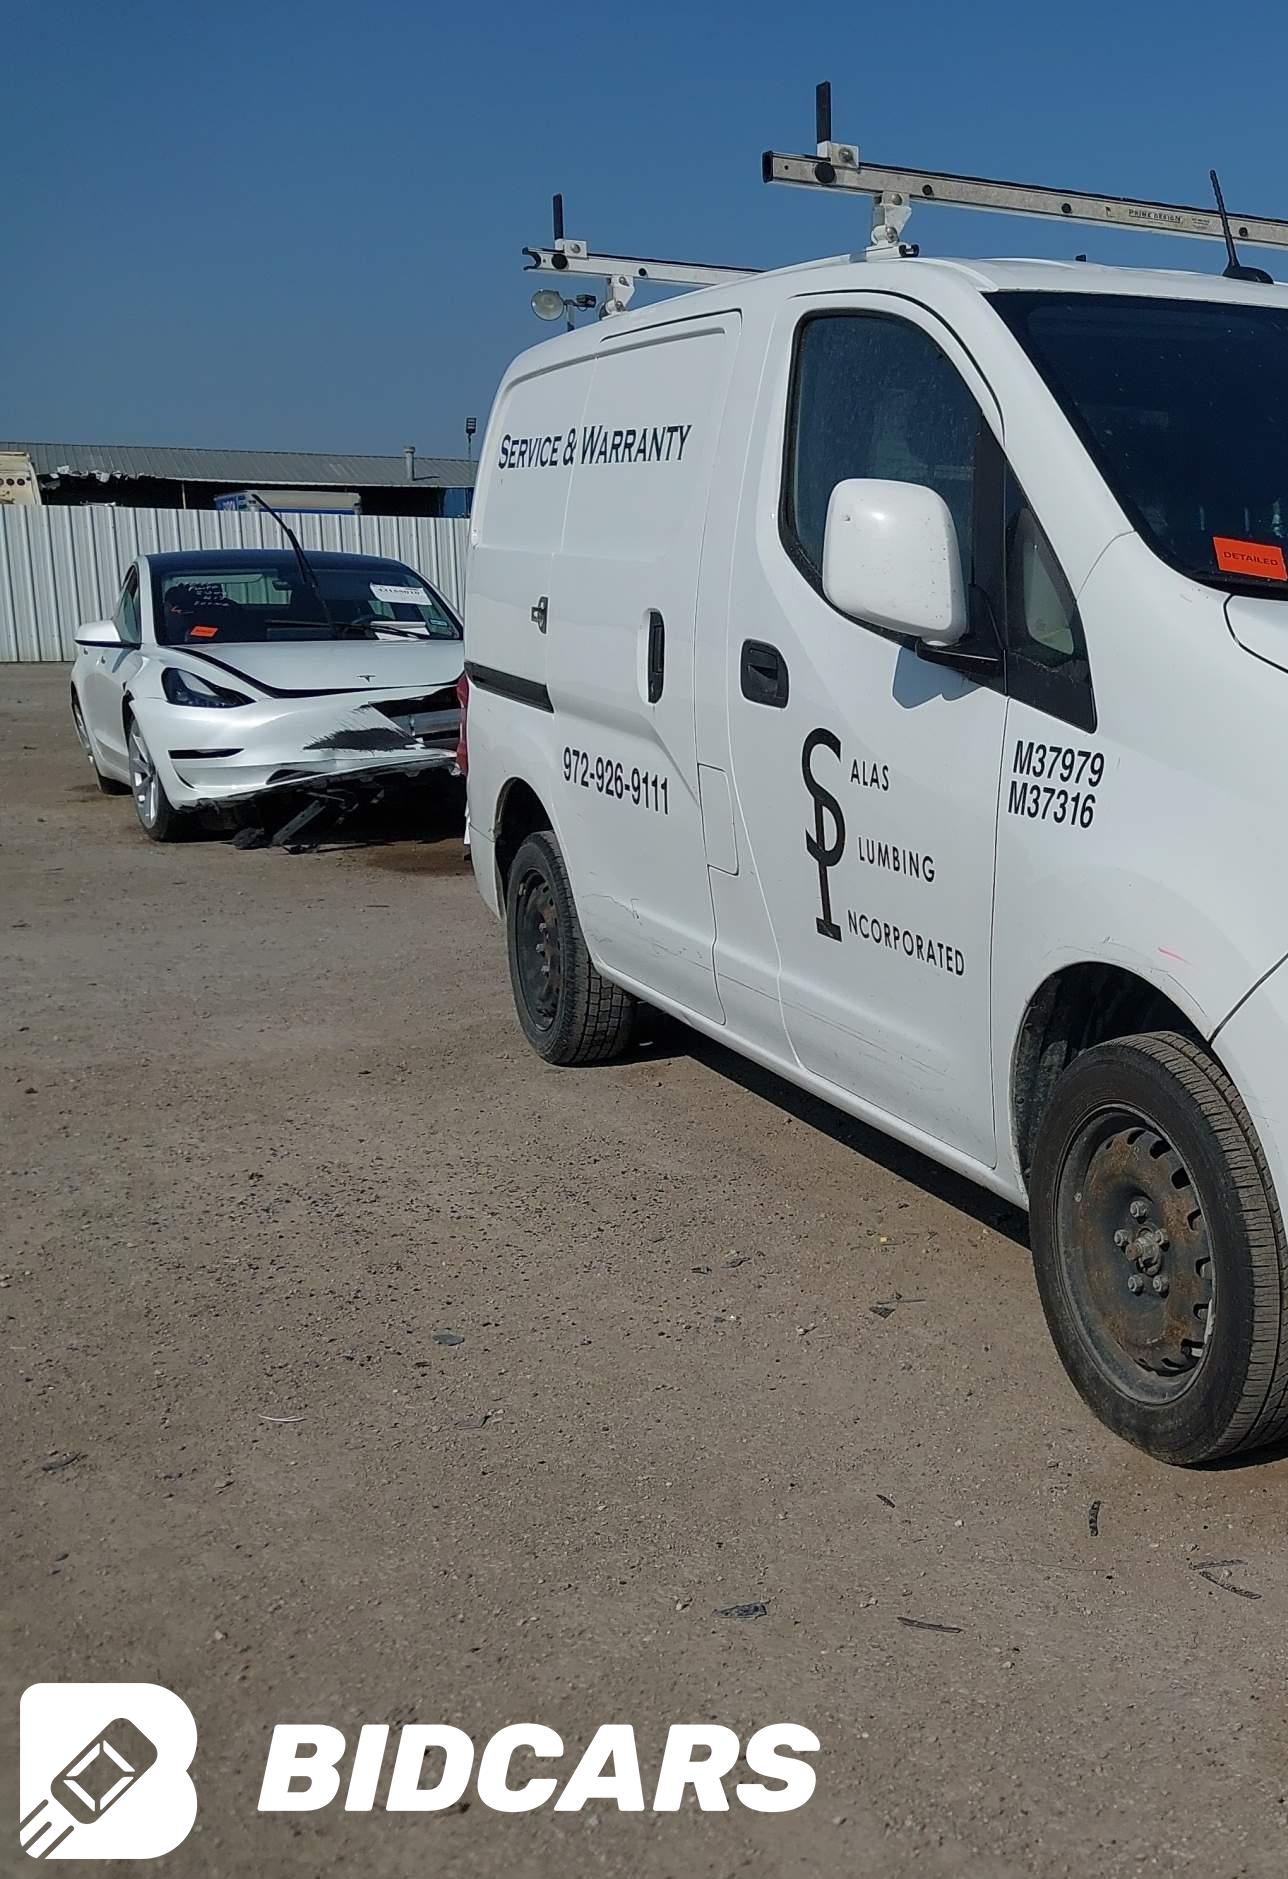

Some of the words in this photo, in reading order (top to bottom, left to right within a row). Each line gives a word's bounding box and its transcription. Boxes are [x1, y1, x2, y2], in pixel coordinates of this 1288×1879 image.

[498, 434, 562, 469] SERVICE
[562, 427, 578, 466] &
[580, 424, 693, 465] WARRANTY
[1223, 551, 1279, 567] DETAILED
[563, 746, 669, 816] 972-926-9111
[850, 759, 889, 792] ALAS
[1013, 740, 1105, 787] M37979
[1008, 780, 1096, 829] M37316
[858, 836, 936, 883] LUMBING
[847, 909, 965, 977] NCORPORATED
